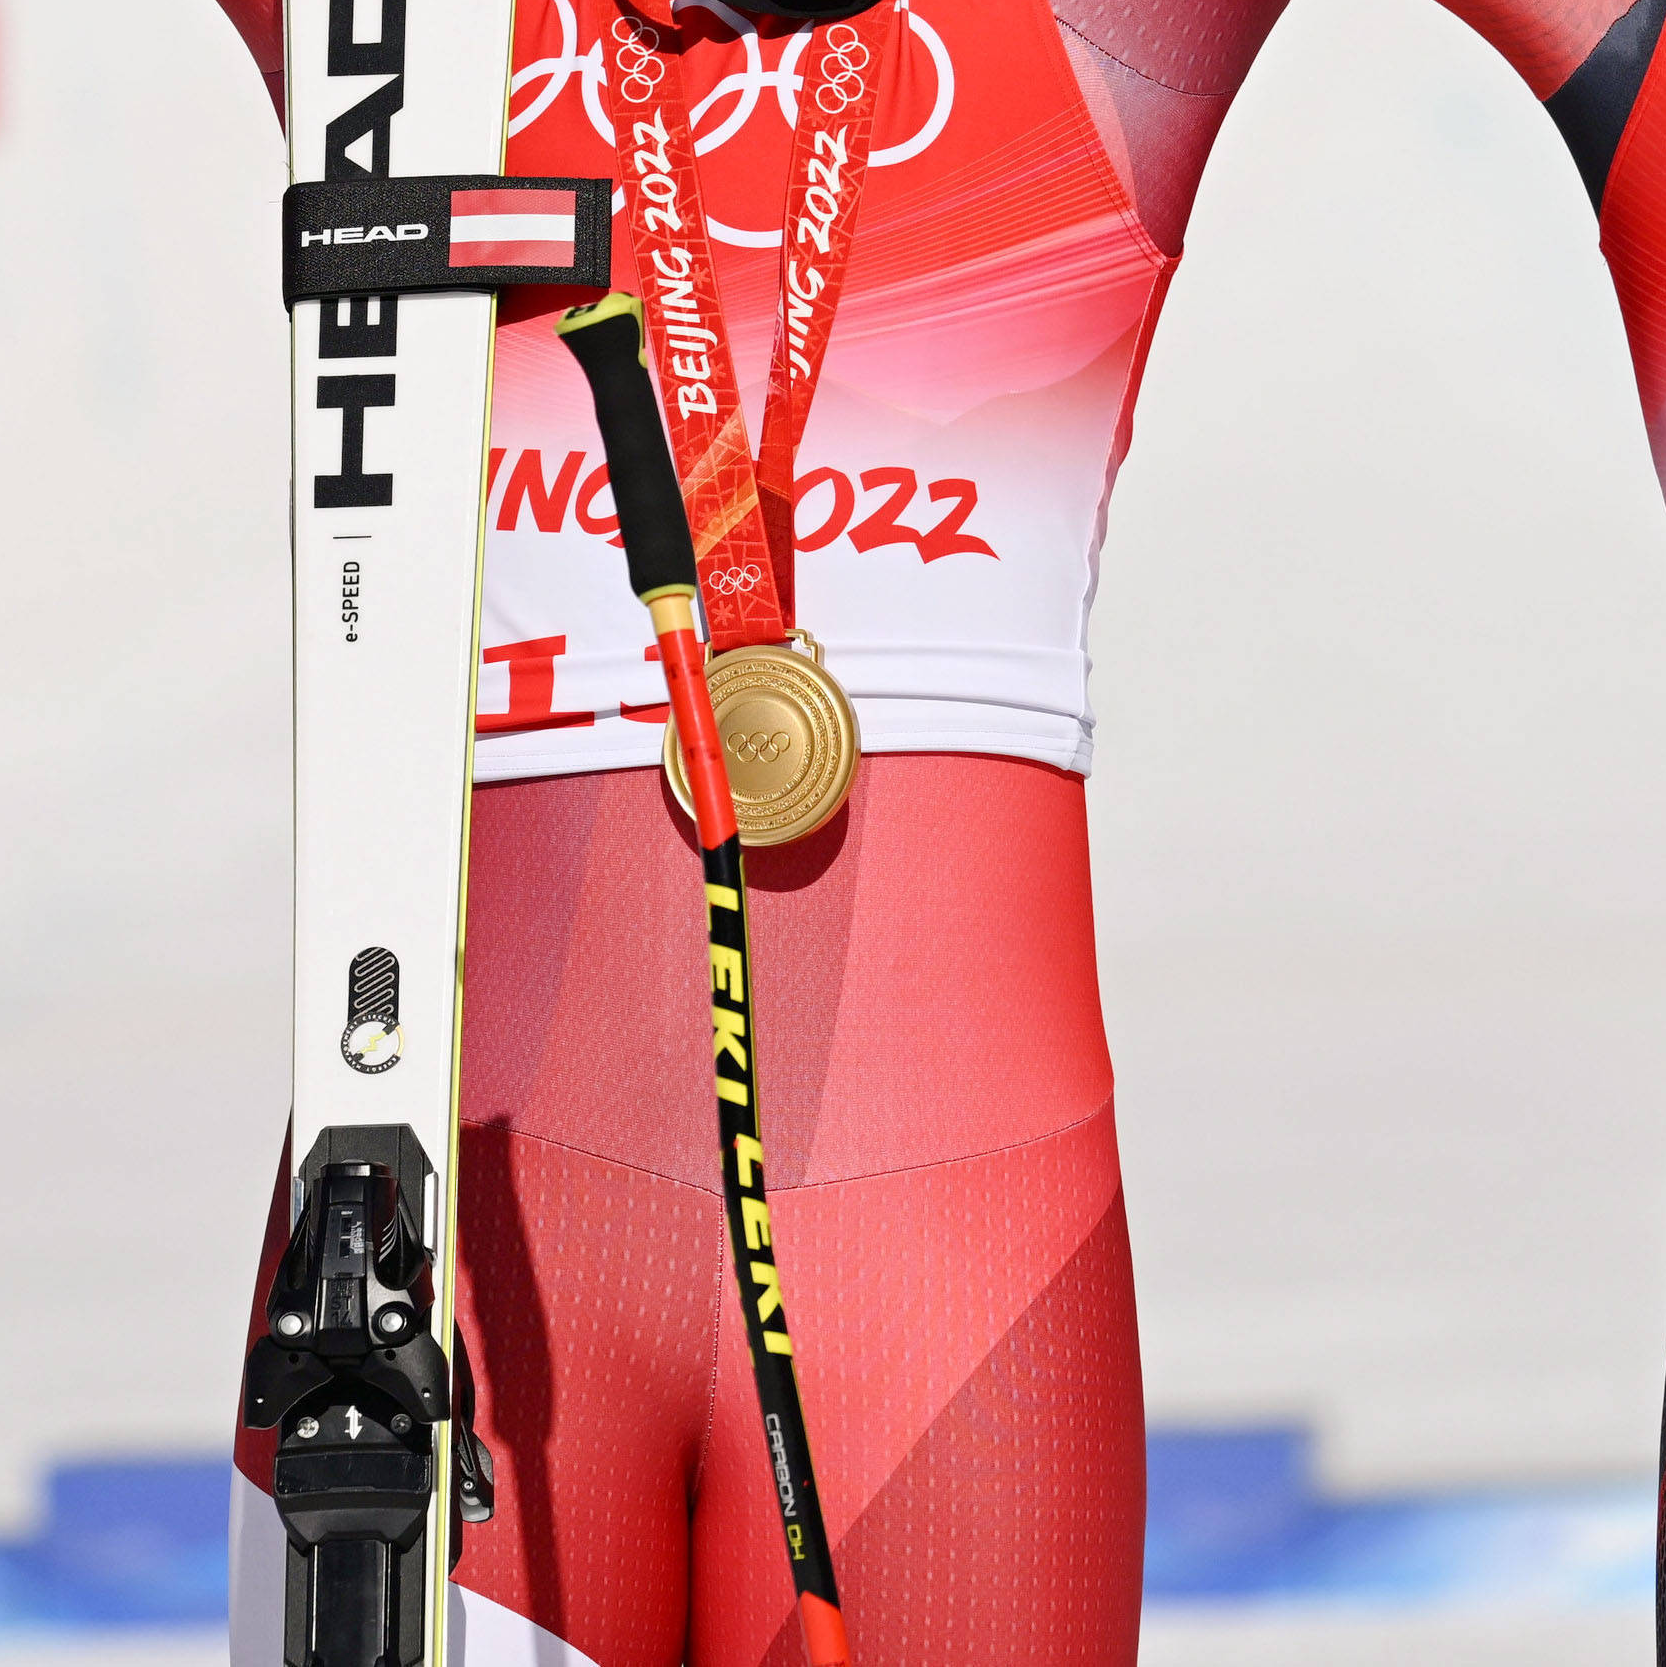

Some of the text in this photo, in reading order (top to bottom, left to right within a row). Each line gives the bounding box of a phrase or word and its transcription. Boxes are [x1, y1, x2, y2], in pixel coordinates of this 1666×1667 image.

[301, 222, 430, 248] HEAD
[797, 124, 849, 254] 2022
[632, 111, 719, 419] BEIJING 2022
[793, 466, 1001, 564] 022
[343, 560, 362, 643] e-SPEED
[703, 882, 749, 1107] LEKI
[734, 1132, 793, 1357] LEKI
[765, 1413, 796, 1519] CARBON
